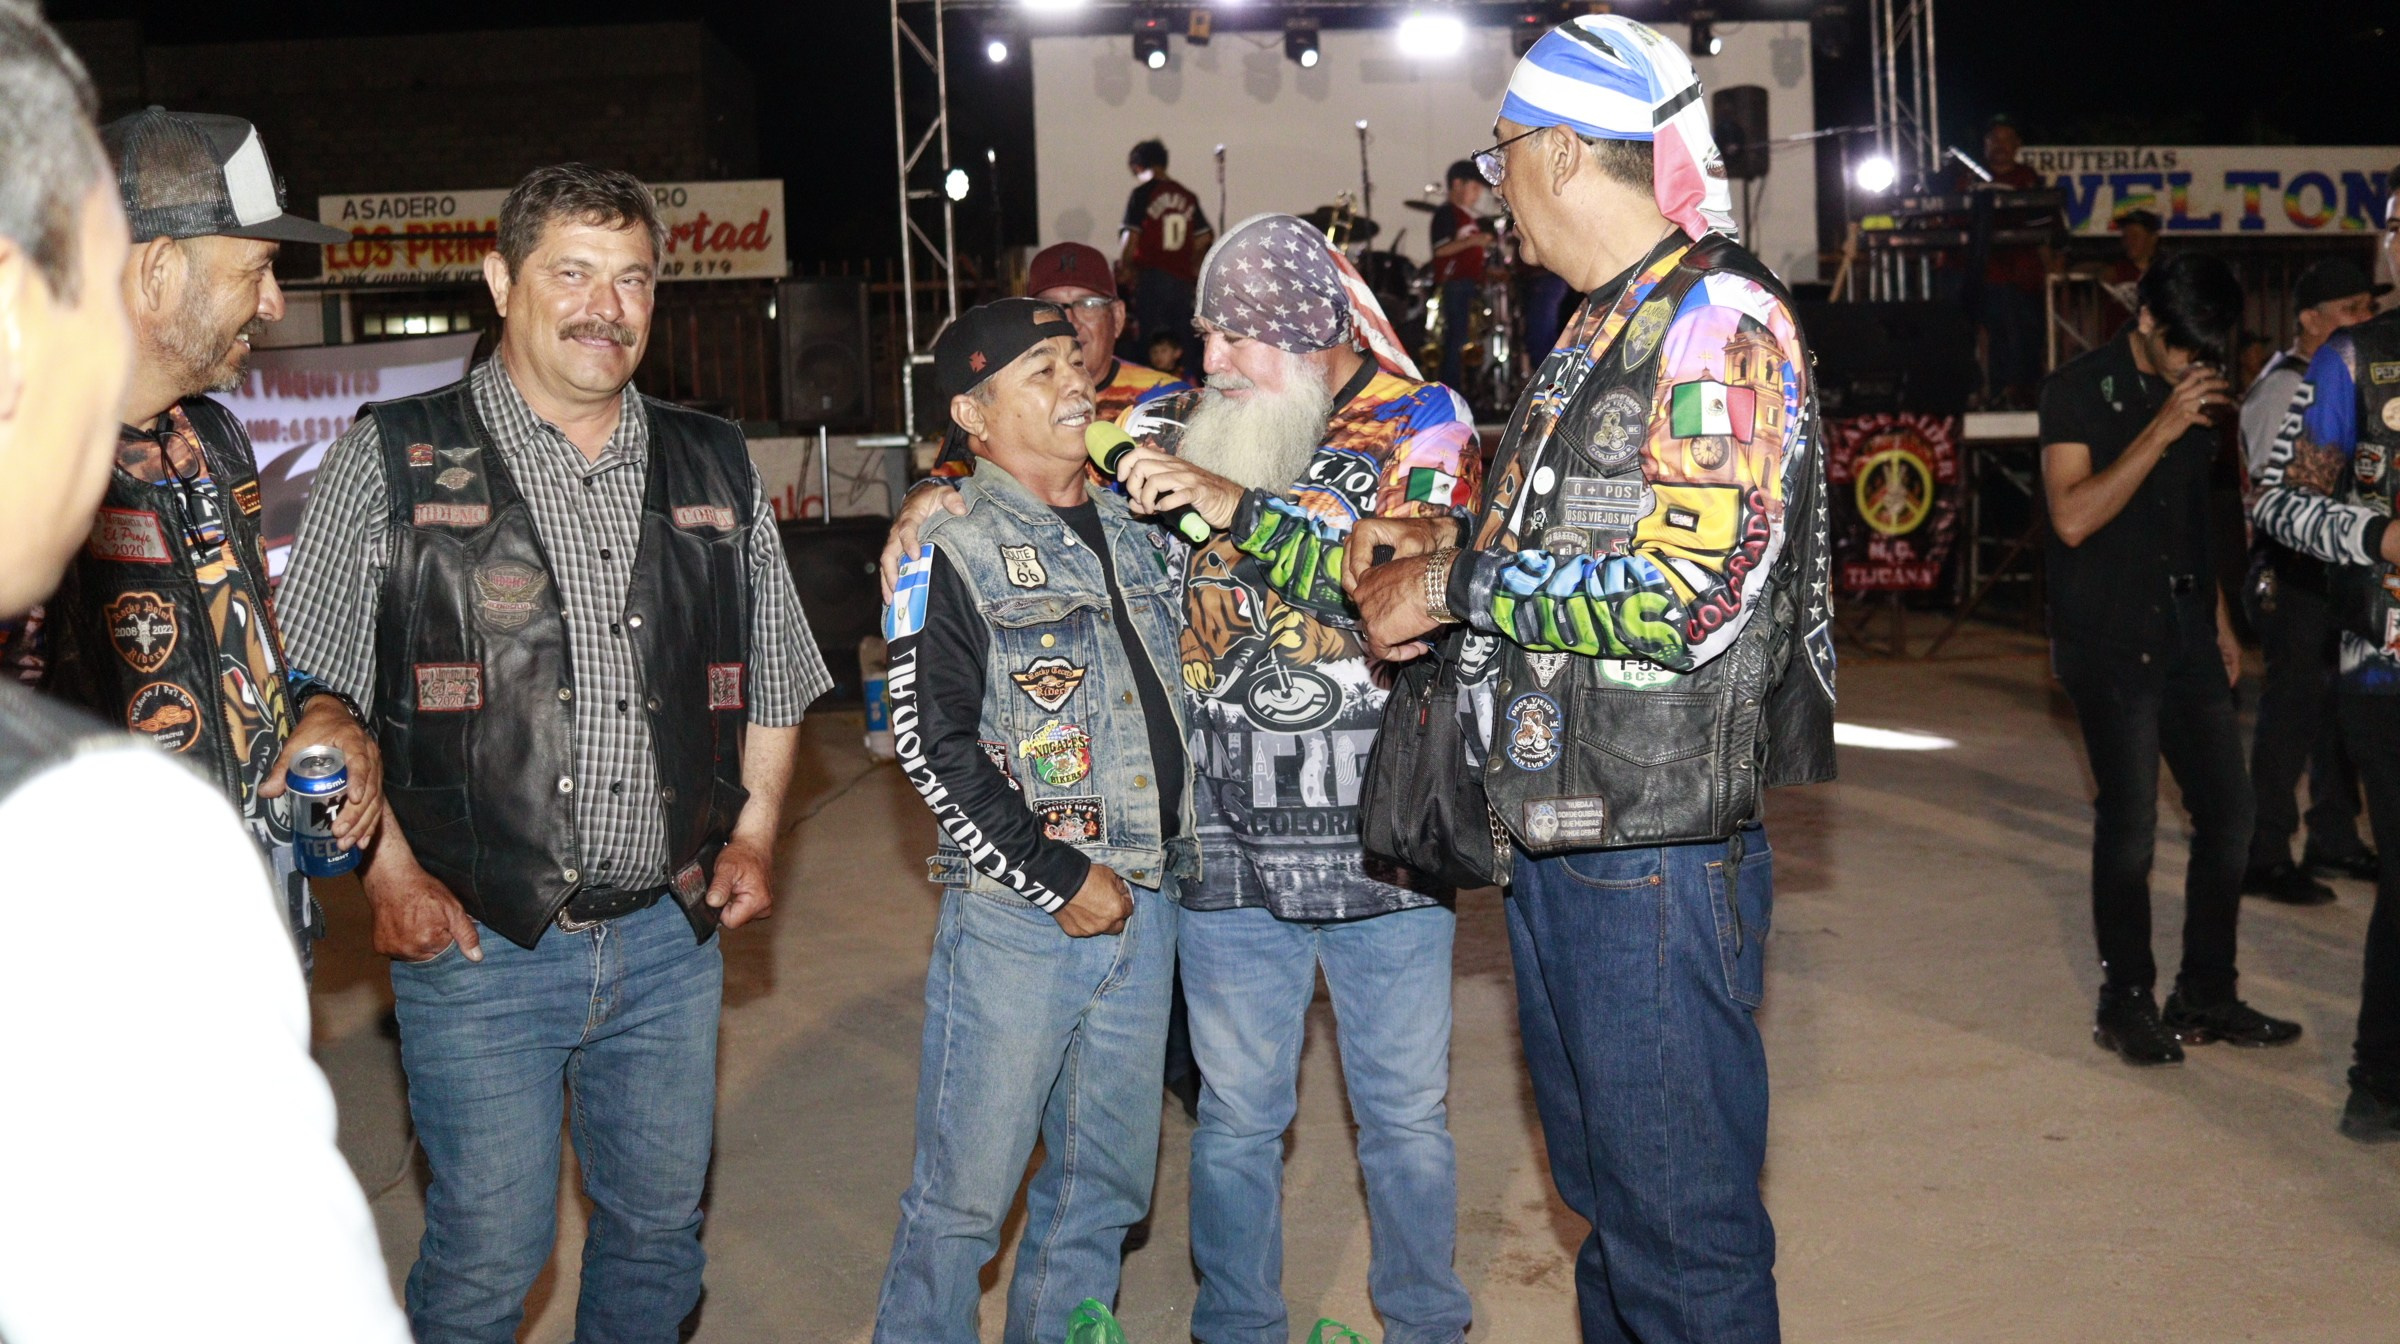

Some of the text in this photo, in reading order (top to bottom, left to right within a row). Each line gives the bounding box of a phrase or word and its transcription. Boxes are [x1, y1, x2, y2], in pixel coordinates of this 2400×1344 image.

[342, 196, 456, 220] ASADERO
[667, 207, 772, 254] rtad
[326, 218, 498, 270] LOS PRIM
[1605, 485, 1632, 498] POS
[1589, 511, 1619, 524] VIEJOS
[113, 543, 145, 556] 2020
[1003, 548, 1031, 560] ROUTE
[1017, 567, 1040, 583] 66
[114, 624, 173, 637] 2008 2022
[1623, 671, 1657, 682] BCS
[1511, 697, 1555, 716] OSOS VIEJOS
[1034, 736, 1086, 760] NOGALES
[1050, 771, 1082, 784] BIKERS
[1251, 810, 1358, 836] COLORA
[301, 837, 341, 858] TEC
[327, 852, 350, 863] LIGHT
